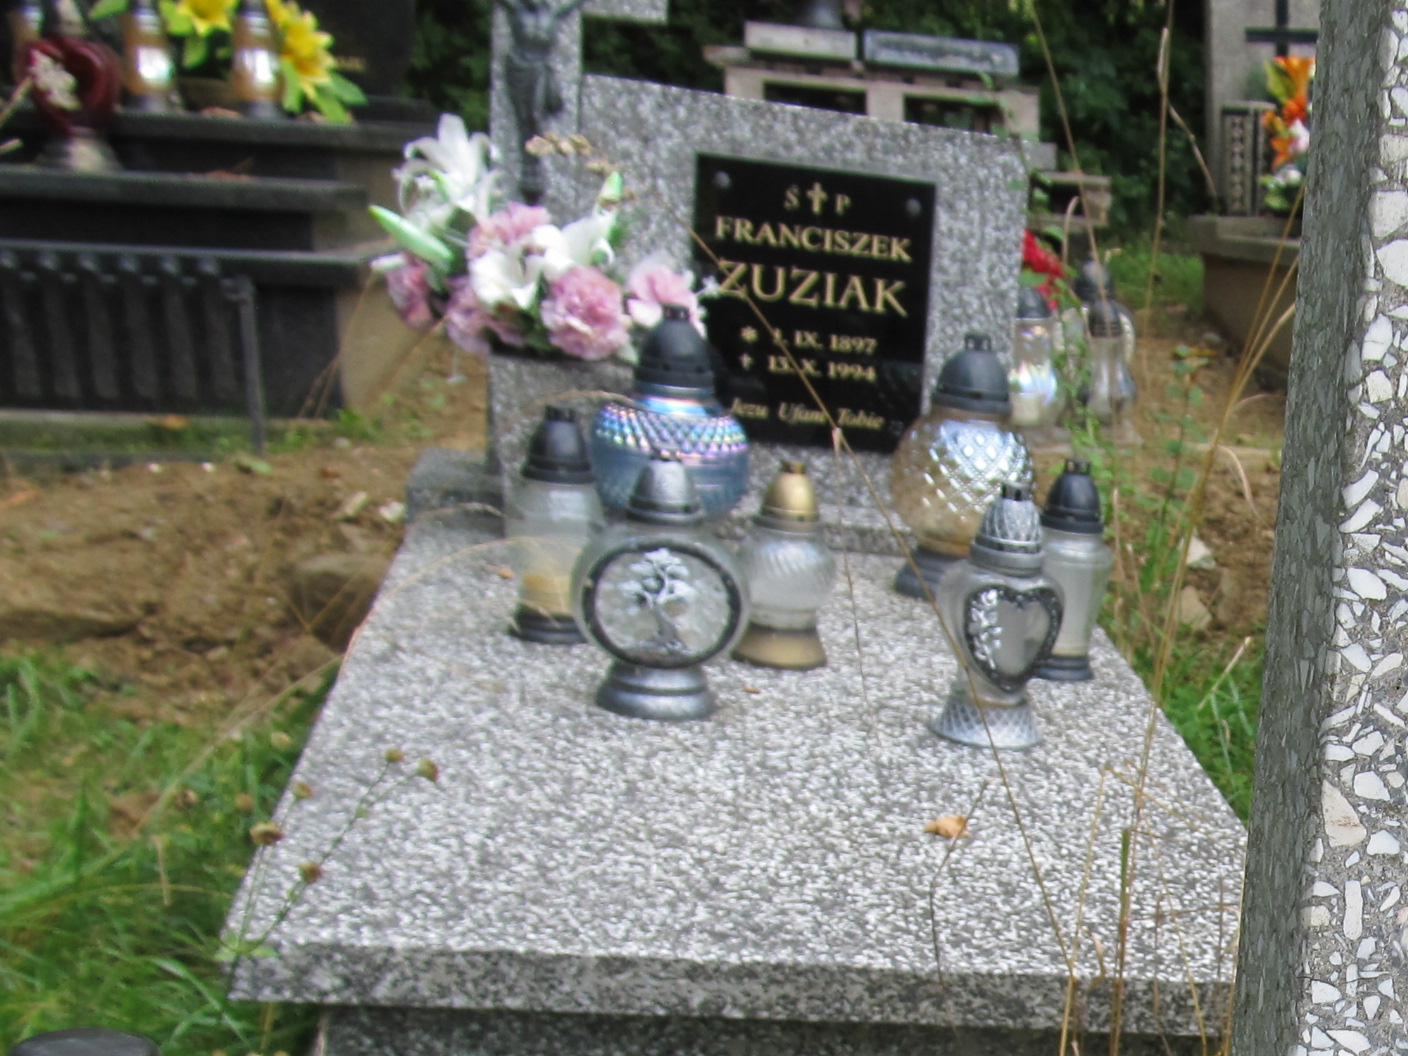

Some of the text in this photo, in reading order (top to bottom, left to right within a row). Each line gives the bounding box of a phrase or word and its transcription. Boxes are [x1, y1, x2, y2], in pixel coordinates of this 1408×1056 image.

[714, 215, 912, 263] FRANCISZEK
[718, 258, 909, 318] ZUZIAK
[827, 361, 877, 383] 1994
[837, 408, 885, 430] Tobie
